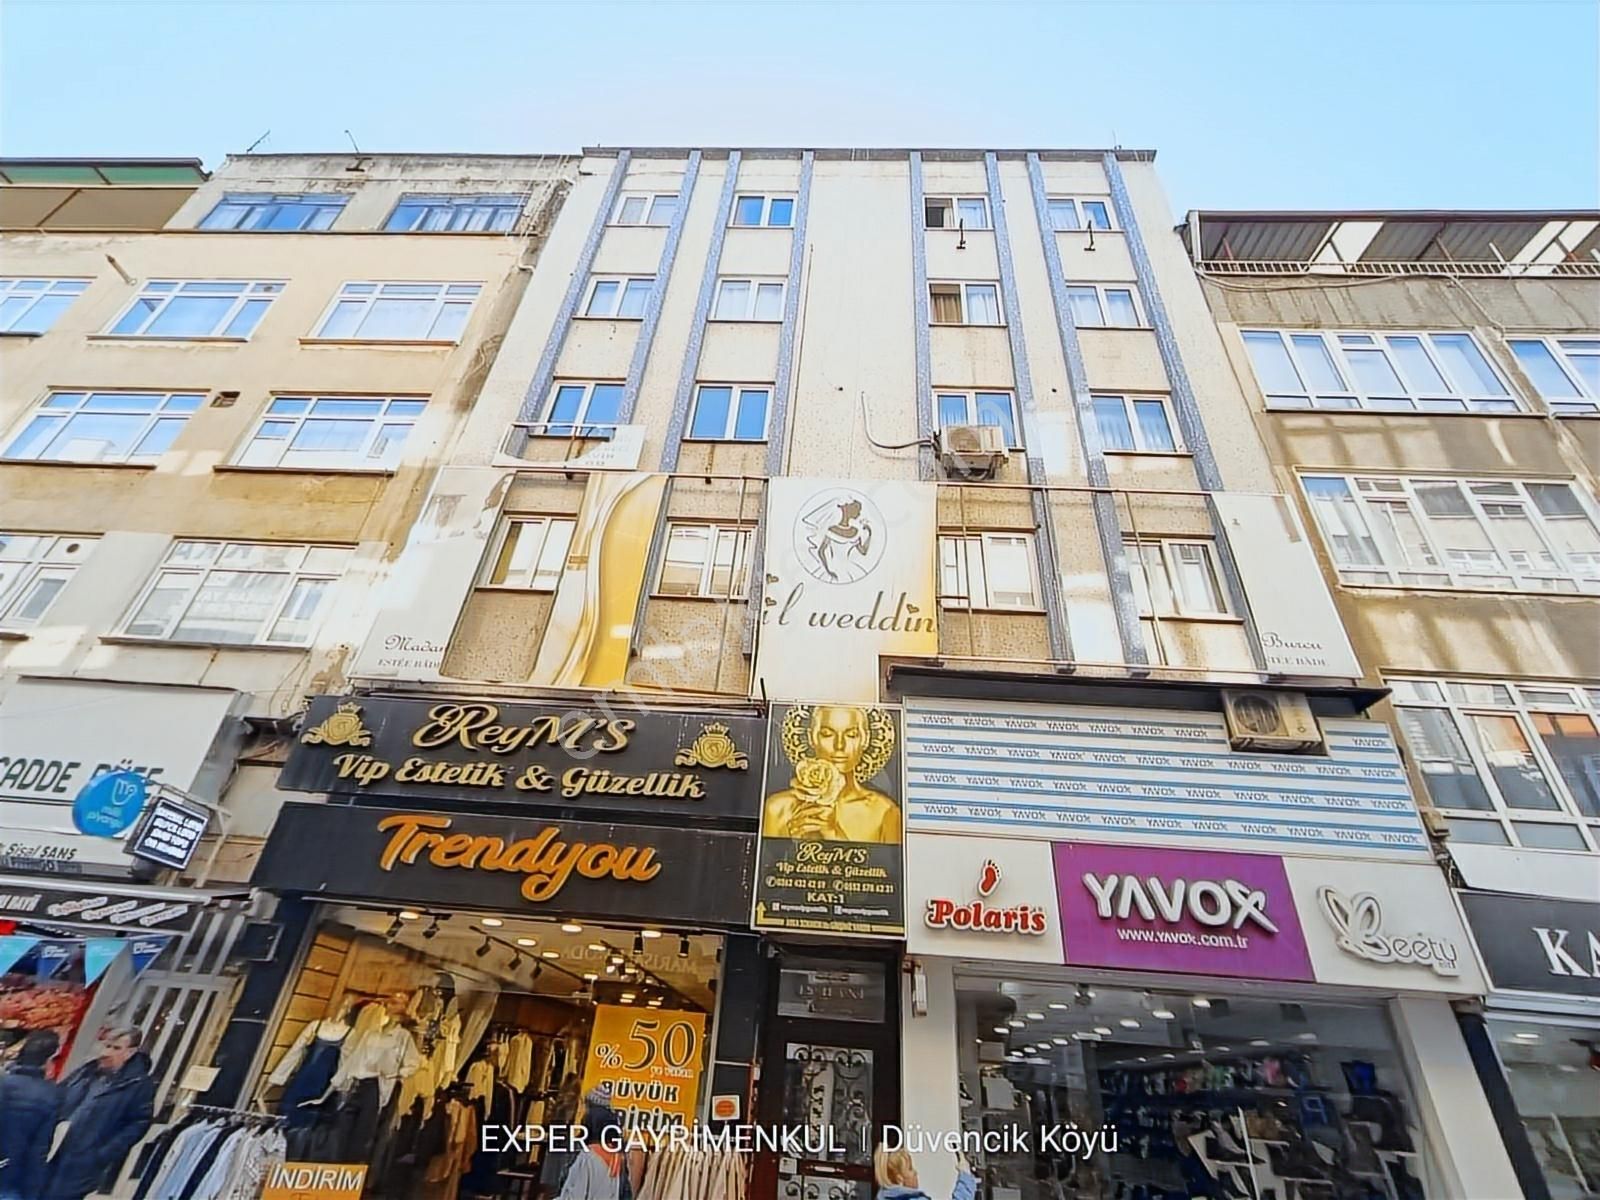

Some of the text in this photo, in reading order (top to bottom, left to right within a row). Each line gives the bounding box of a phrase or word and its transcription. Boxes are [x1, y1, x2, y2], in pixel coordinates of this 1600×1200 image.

[1262, 632, 1322, 650] Burcu
[333, 753, 707, 800] Vip Estetik & Güzellik
[376, 813, 662, 903] Trendyou
[832, 865, 843, 876] &
[806, 892, 846, 904] KAT:1
[1082, 872, 1279, 933] YAVOX
[926, 899, 1047, 934] Polaris
[595, 1019, 696, 1071] %50
[270, 1165, 367, 1193] İNDİRİM
